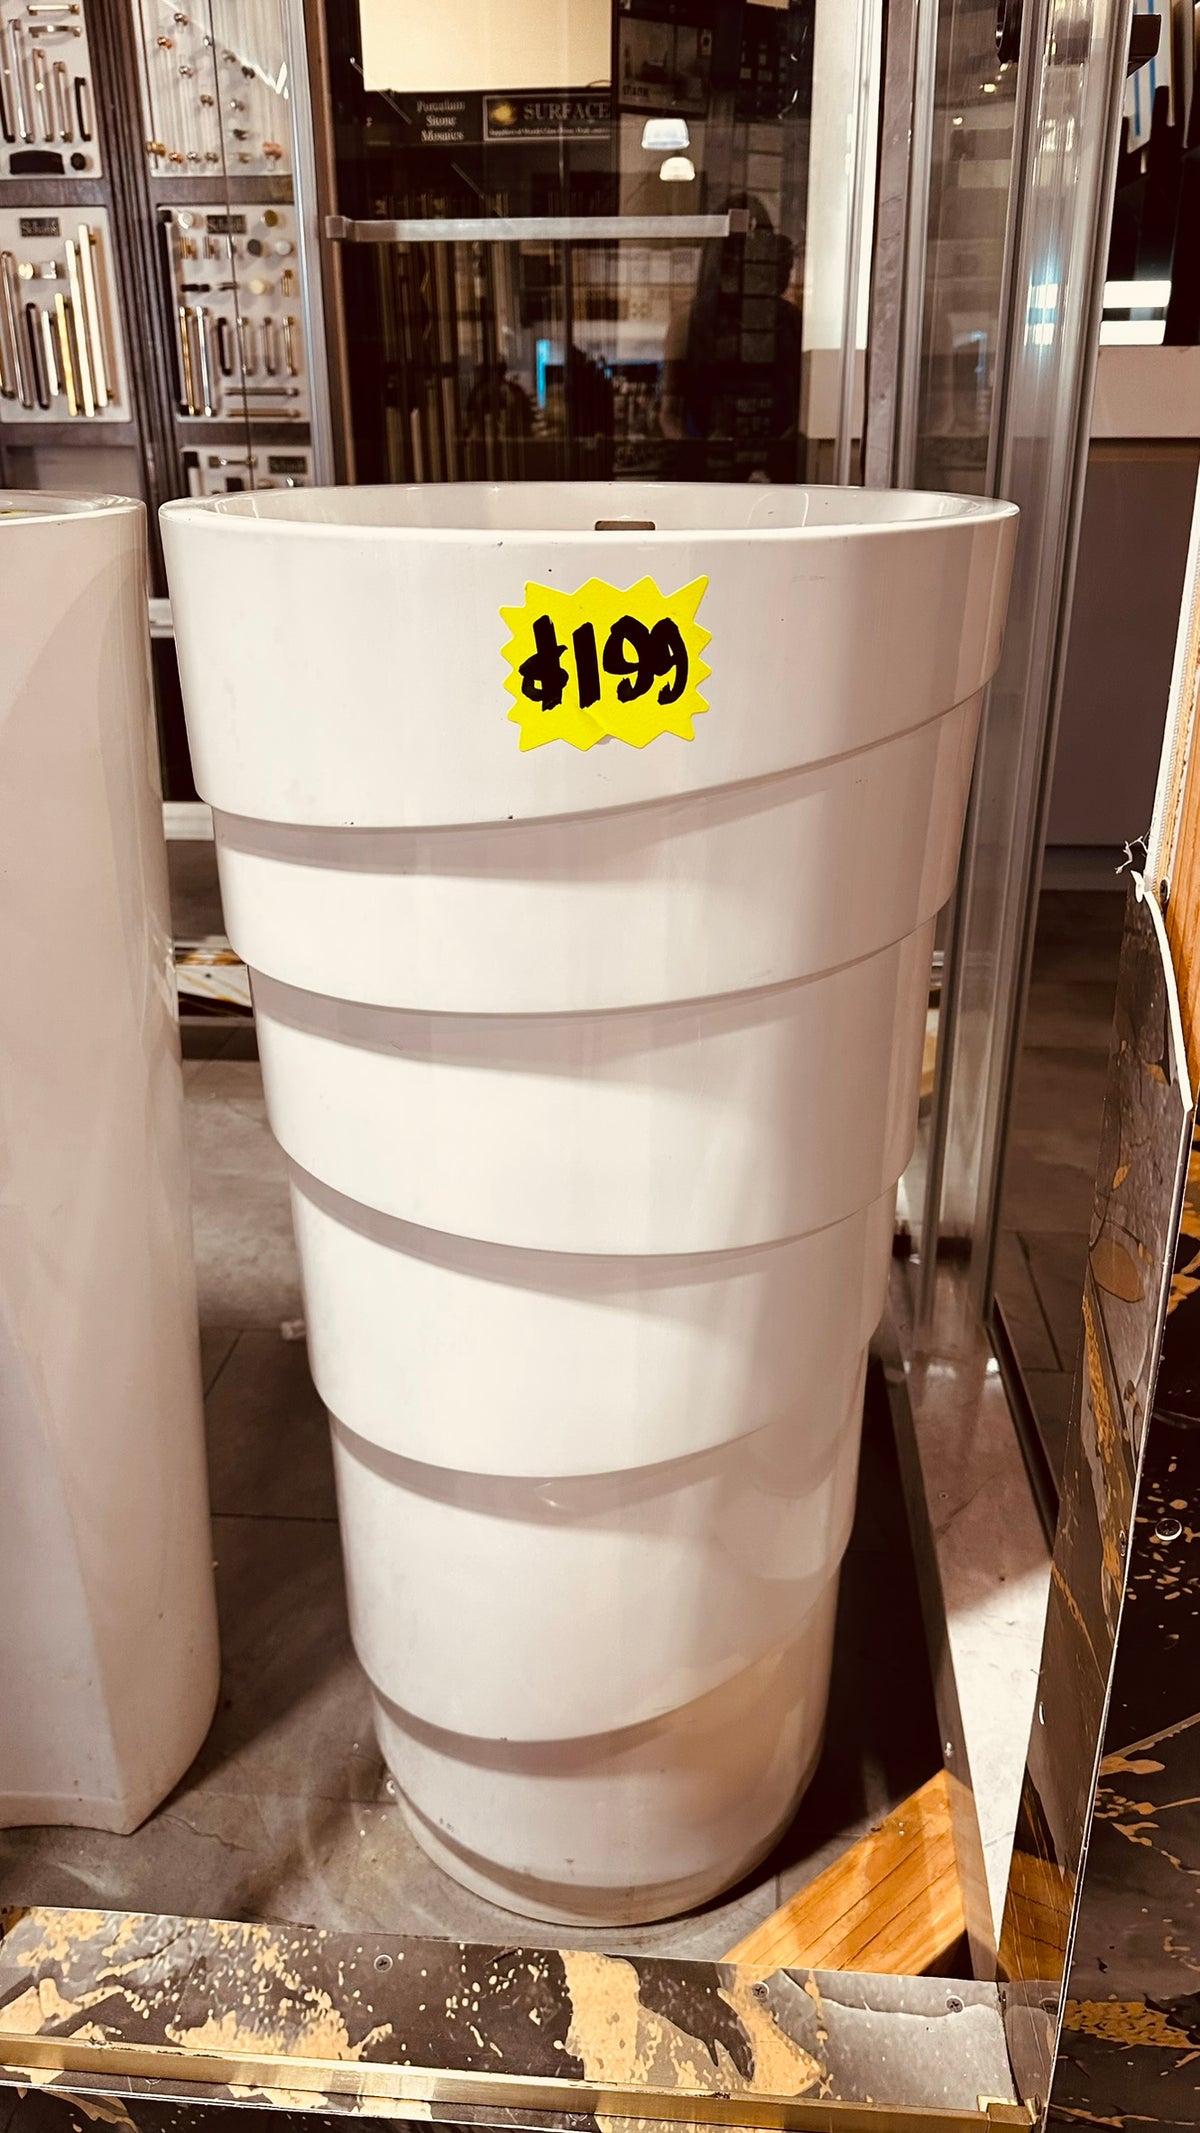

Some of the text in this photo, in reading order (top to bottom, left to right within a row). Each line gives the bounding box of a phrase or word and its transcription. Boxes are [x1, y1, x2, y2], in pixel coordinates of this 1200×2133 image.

[425, 113, 457, 127] Stone
[420, 129, 465, 142] Mosaics
[518, 614, 689, 712] $199
